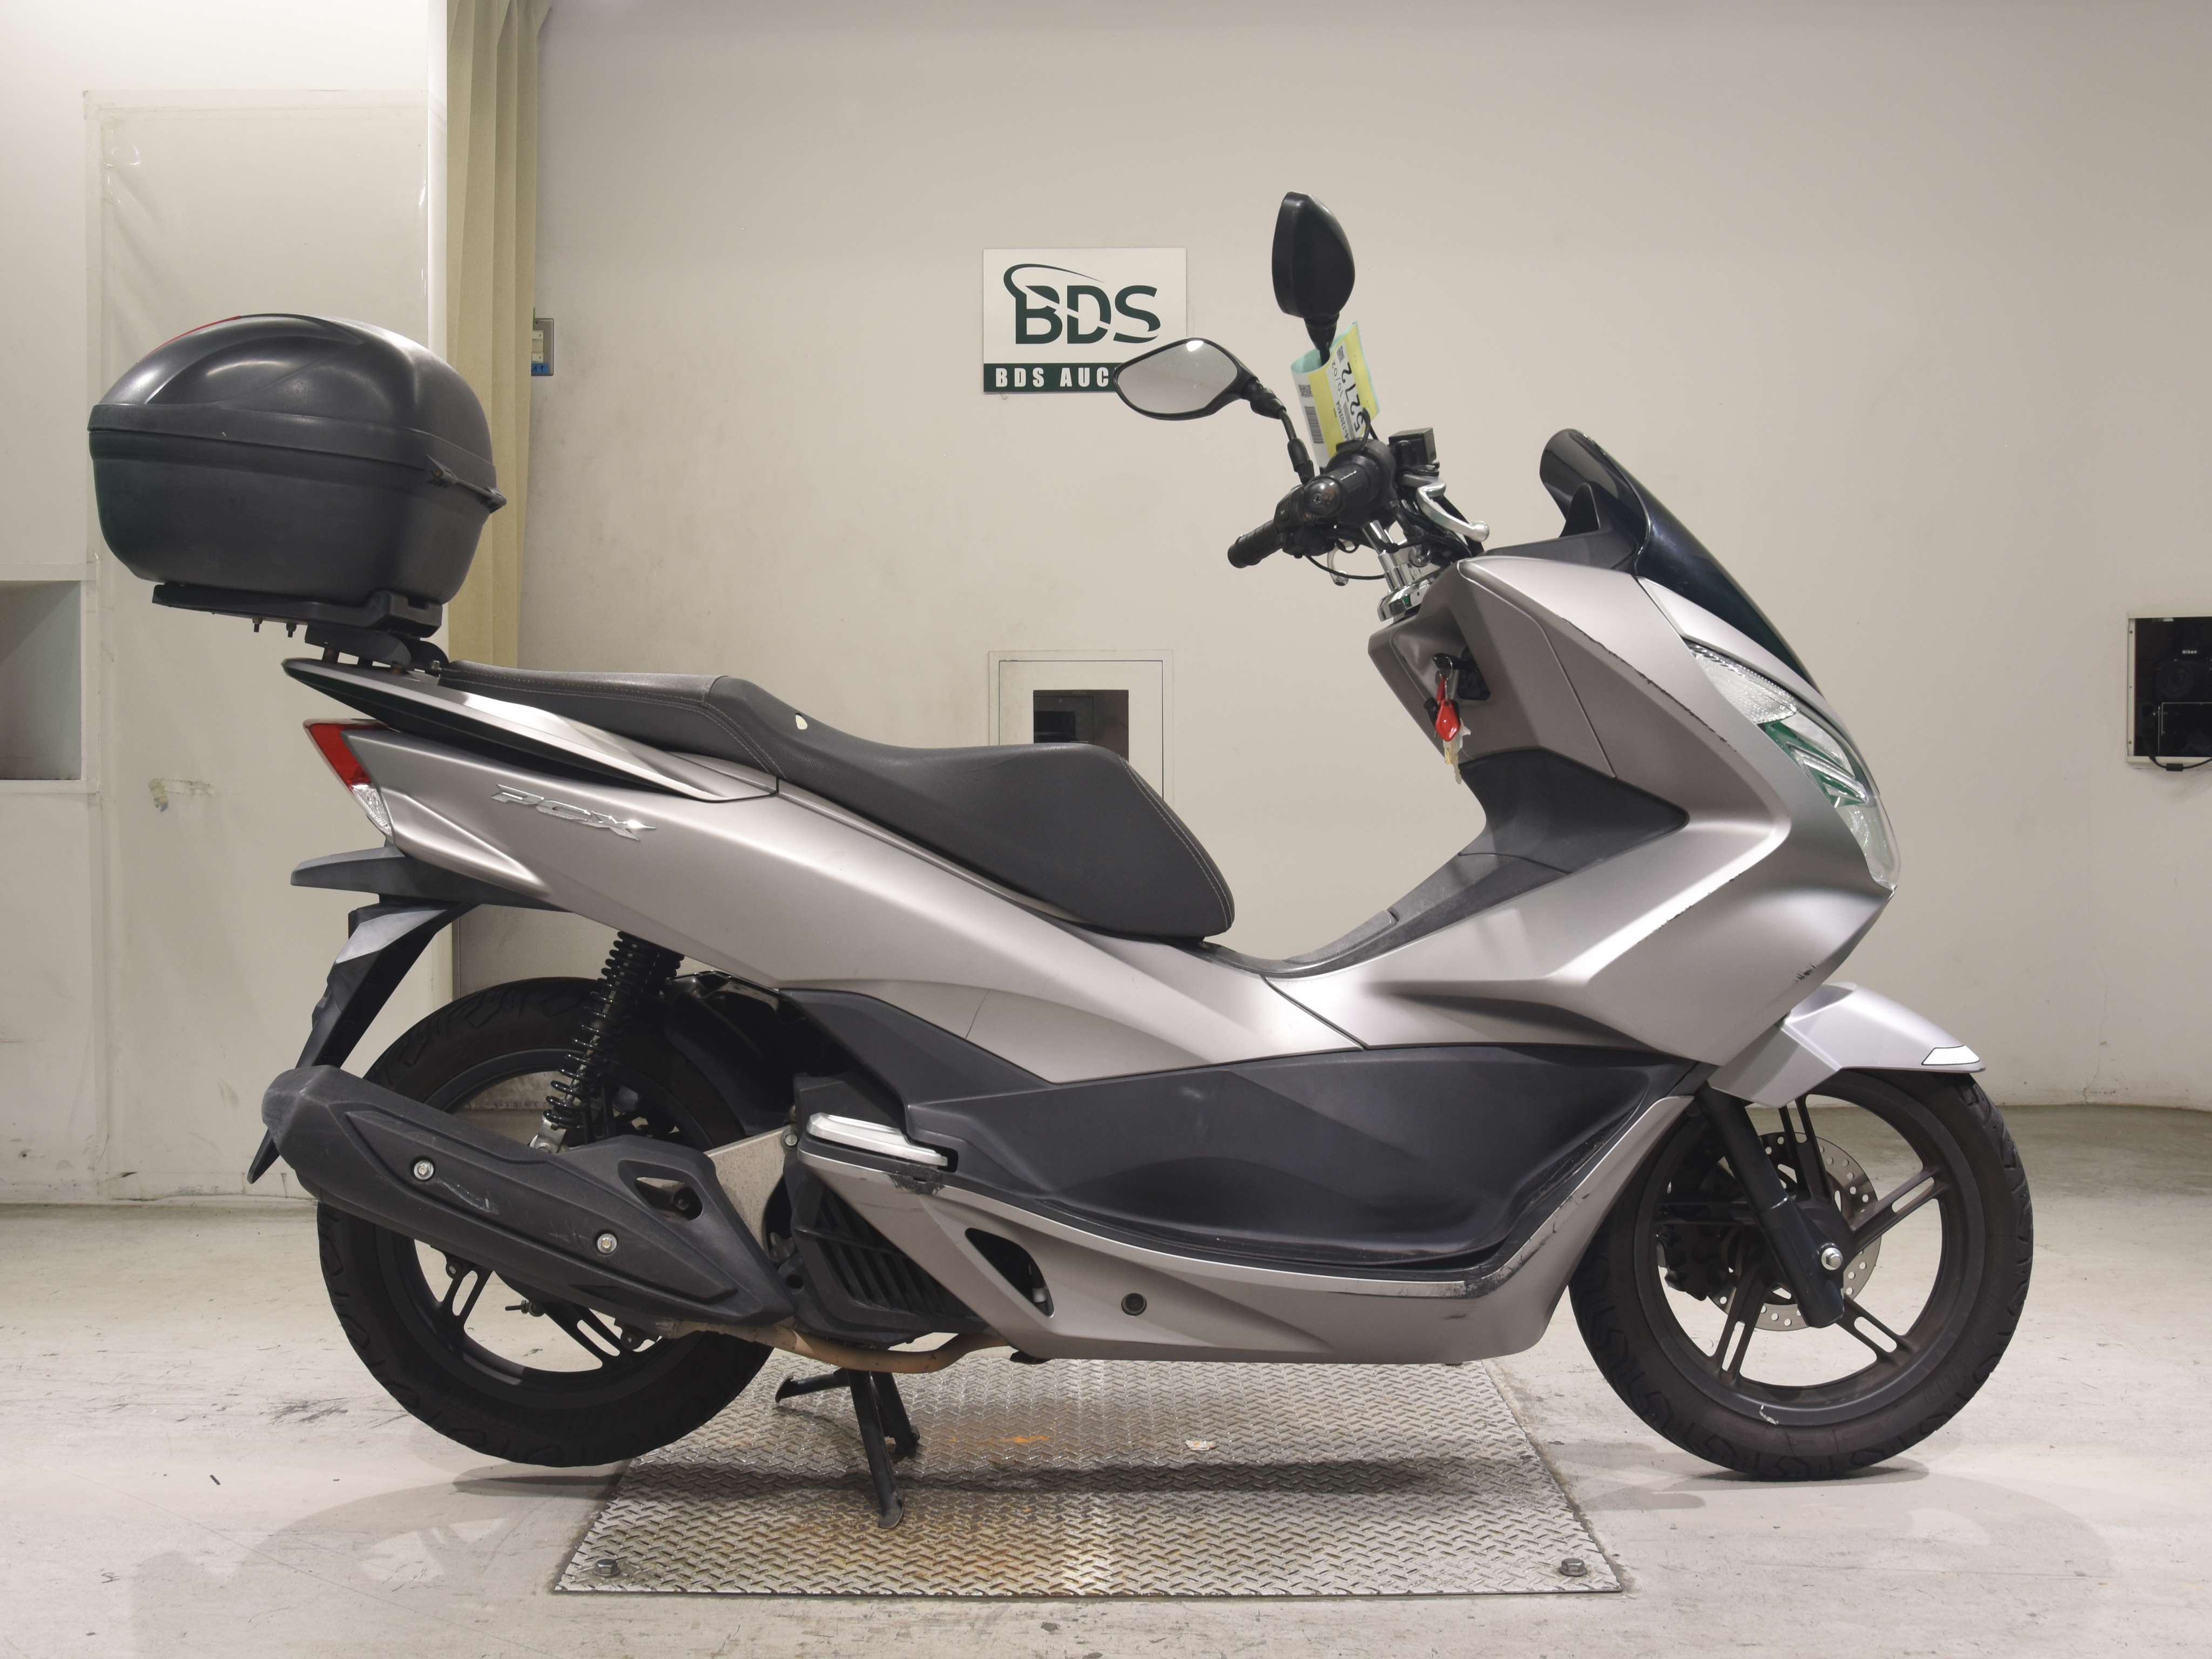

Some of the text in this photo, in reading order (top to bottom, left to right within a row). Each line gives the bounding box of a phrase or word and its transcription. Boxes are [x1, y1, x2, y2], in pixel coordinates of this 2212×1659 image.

[1003, 263, 1161, 344] BDS
[995, 367, 1117, 388] BDS AUC
[1341, 361, 1365, 433] 5272
[490, 784, 657, 841] PCX
